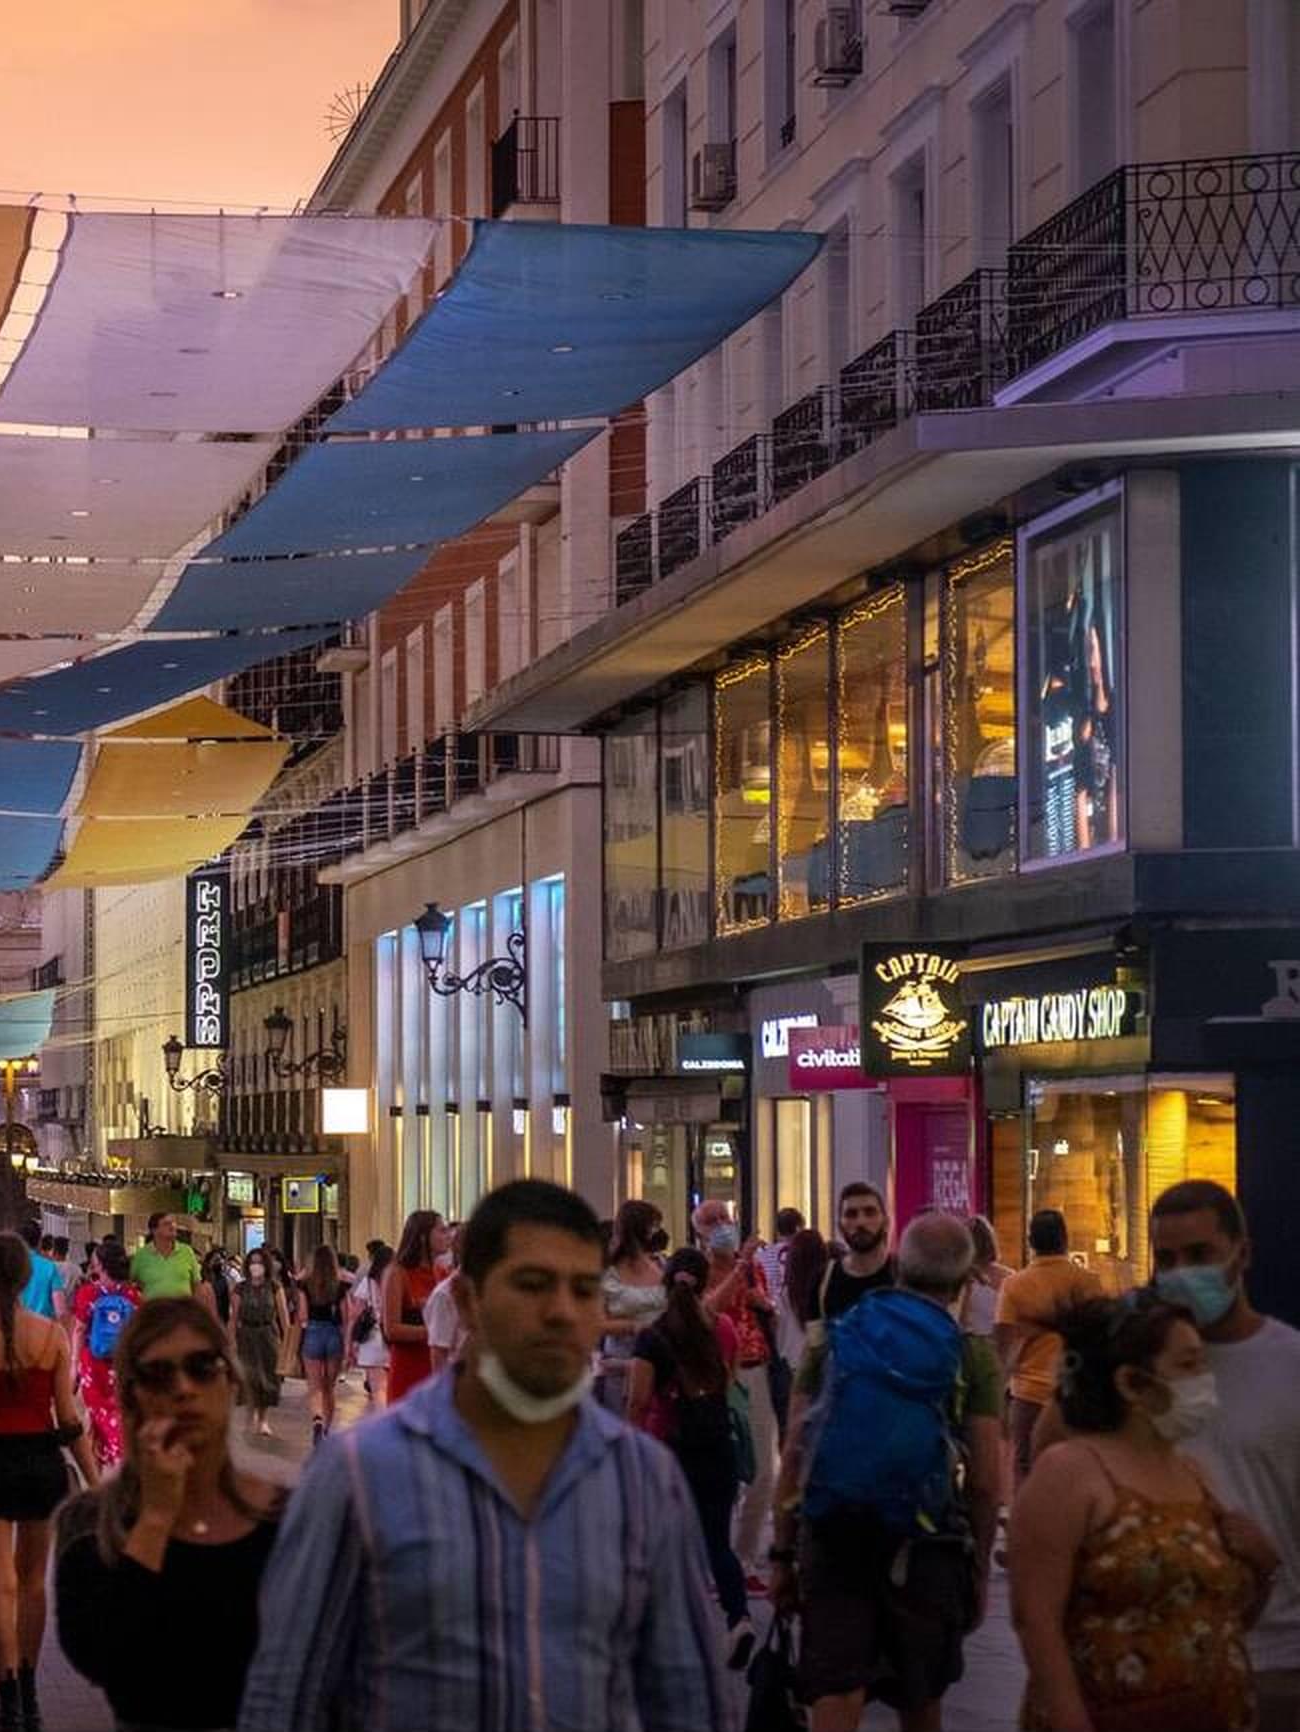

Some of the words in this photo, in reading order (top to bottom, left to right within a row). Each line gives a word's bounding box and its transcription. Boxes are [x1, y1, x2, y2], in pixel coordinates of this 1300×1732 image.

[875, 952, 960, 983] CAPTAIN
[982, 998, 1040, 1049] CAPTAIN
[1040, 988, 1088, 1042] CANDY
[1087, 987, 1126, 1040] SHOP
